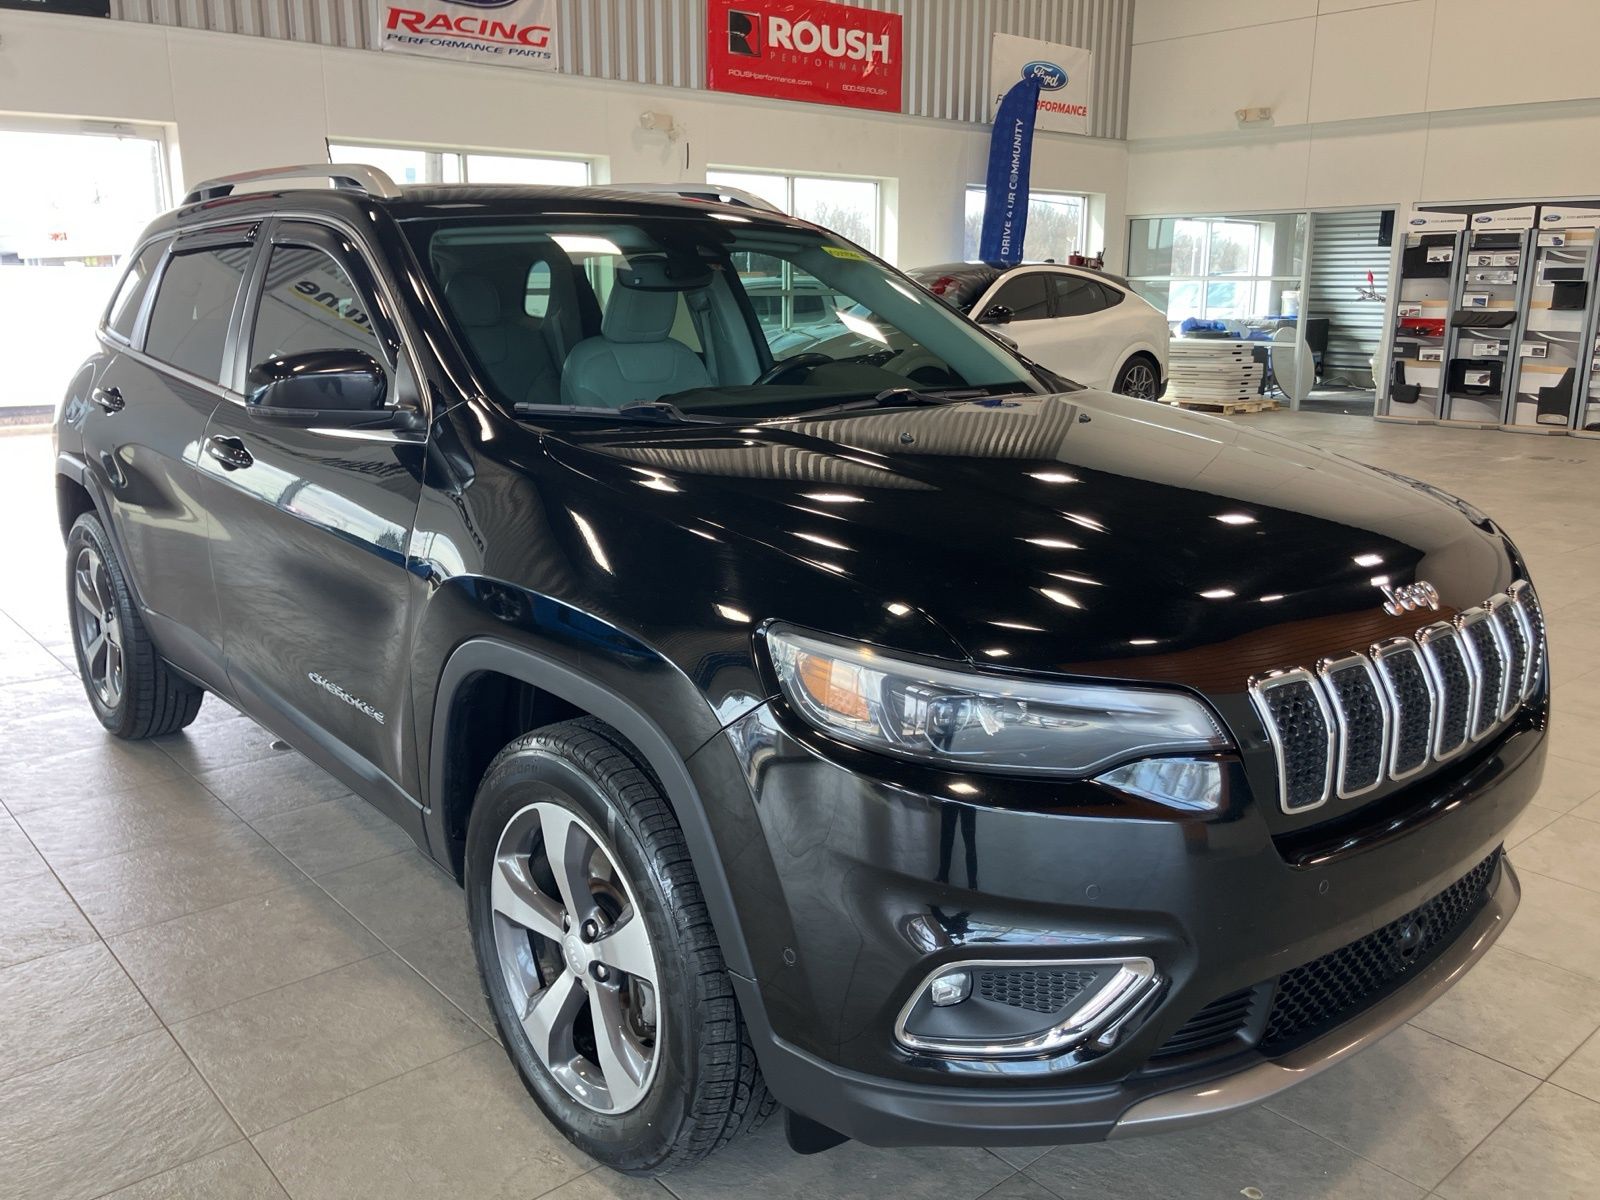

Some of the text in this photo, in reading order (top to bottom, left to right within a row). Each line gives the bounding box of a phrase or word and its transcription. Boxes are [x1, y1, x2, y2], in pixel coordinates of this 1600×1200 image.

[387, 6, 551, 49] RACING
[768, 15, 890, 65] ROUSH
[386, 33, 552, 60] PERFORMANCE PARTS
[1037, 99, 1087, 117] RFORMANCE
[1009, 118, 1024, 190] COMMUNITY
[1007, 192, 1016, 209] UR
[1001, 221, 1011, 255] DRIVE
[1380, 580, 1439, 616] Jeep
[308, 672, 385, 725] CHEROKEE
